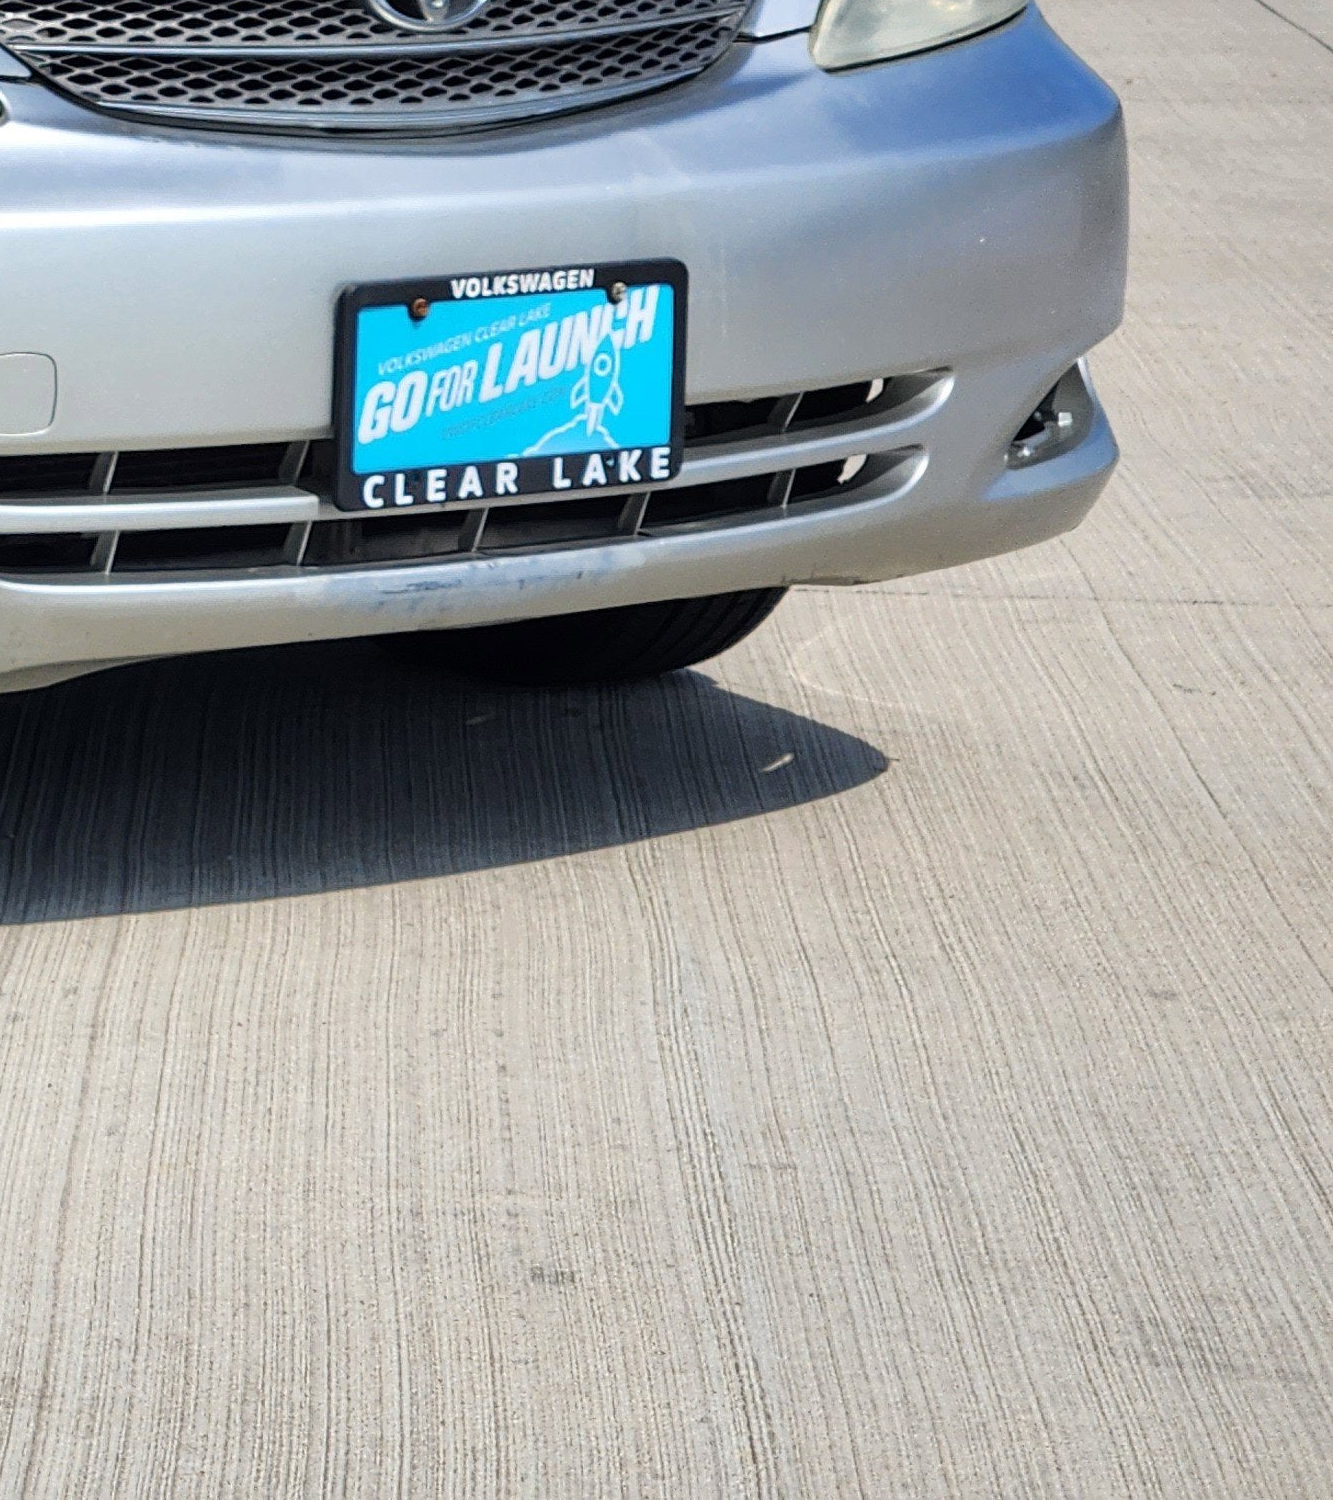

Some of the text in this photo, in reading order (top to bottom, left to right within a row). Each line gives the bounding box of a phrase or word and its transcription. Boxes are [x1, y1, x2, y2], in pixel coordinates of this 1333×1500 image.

[450, 268, 595, 299] VOLKSWAGEN
[357, 370, 429, 445] GO
[425, 359, 478, 418] FOR
[478, 284, 660, 404] LAUNCH
[378, 302, 552, 376] VOLKSWAGEN CLEAR LAKE
[363, 446, 671, 509] CLEAR LAKE
